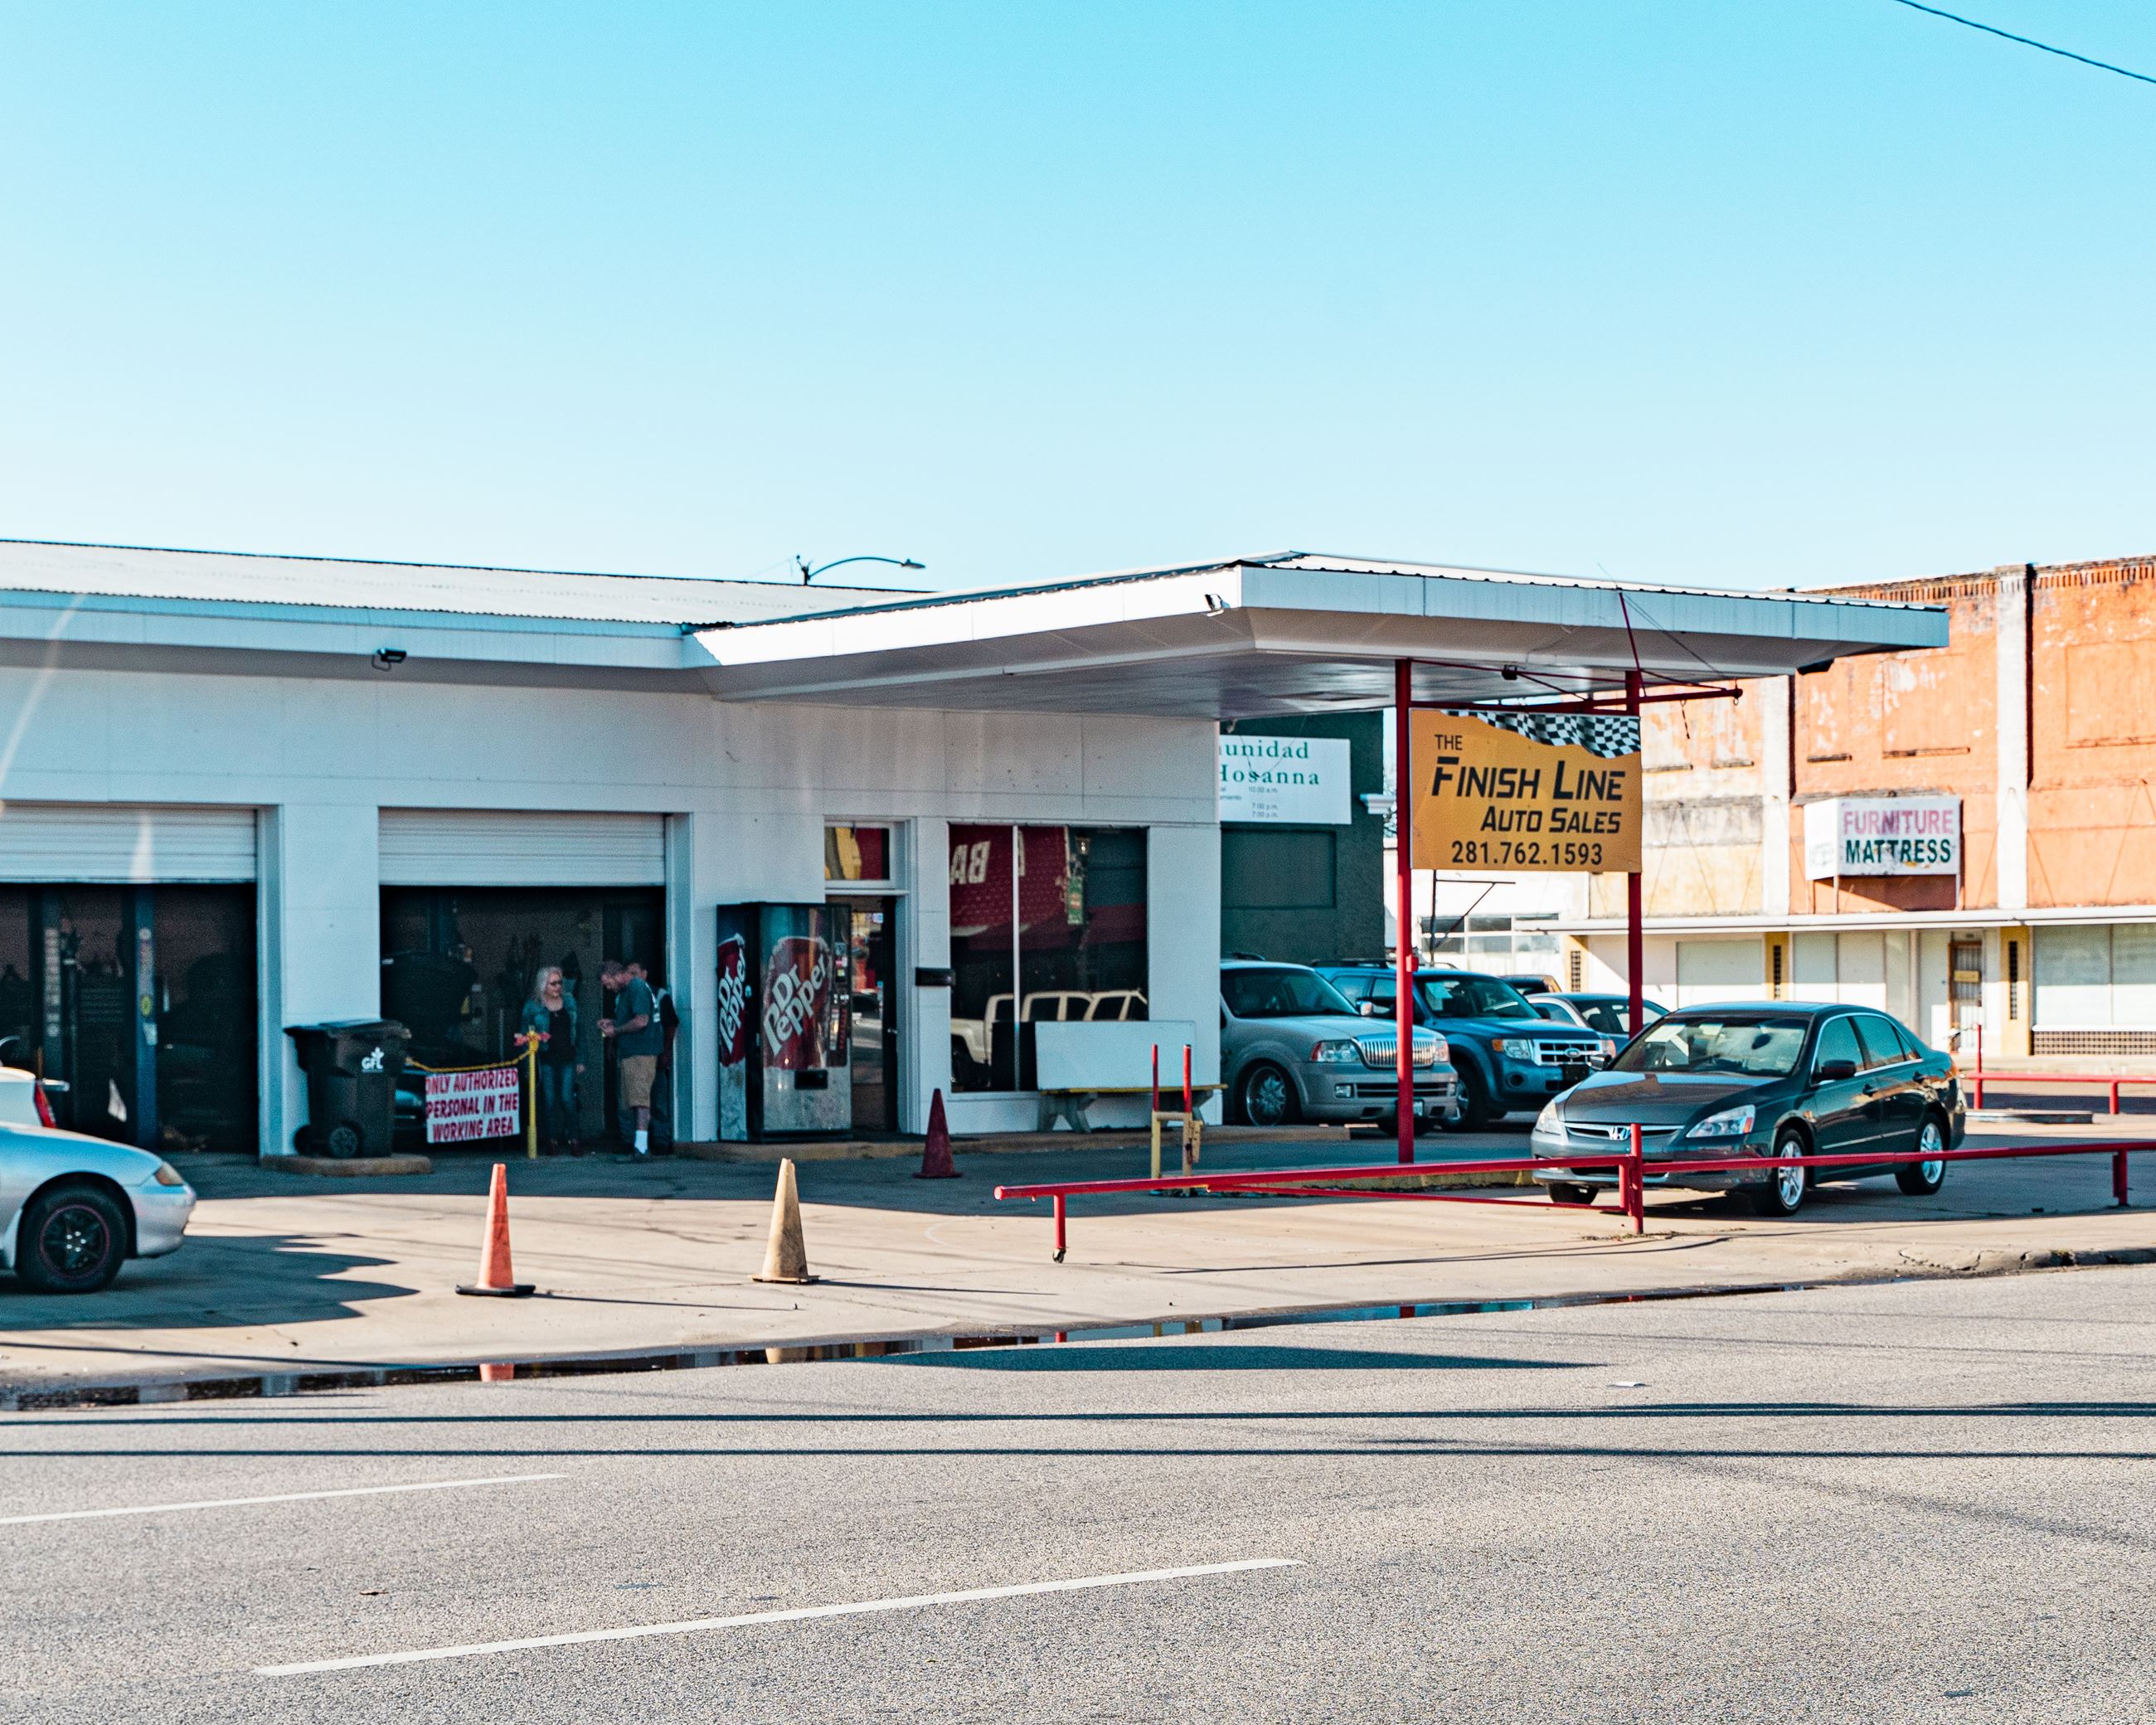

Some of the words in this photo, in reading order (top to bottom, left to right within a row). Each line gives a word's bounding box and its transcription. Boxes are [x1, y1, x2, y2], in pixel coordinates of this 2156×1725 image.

[1434, 734, 1463, 751] THE
[1431, 756, 1541, 799] FINISH
[1552, 760, 1626, 801] LINE
[1480, 805, 1543, 833] AUTO
[1548, 807, 1622, 834] SALES
[1843, 809, 1954, 835] FURNITURE
[1451, 840, 1603, 866] 281.762.1593
[1845, 838, 1952, 864] MATTRESS
[718, 966, 734, 1012] Dr
[772, 963, 802, 1012] Dr
[763, 953, 827, 1057] Pepper
[425, 1075, 451, 1095] ONLY
[453, 1067, 518, 1092] AUTHORIZED
[425, 1096, 480, 1120] PERSONAL
[483, 1095, 495, 1114] IN
[498, 1093, 518, 1112] THE
[432, 1119, 483, 1143] WORKING
[486, 1115, 513, 1137] AREA
